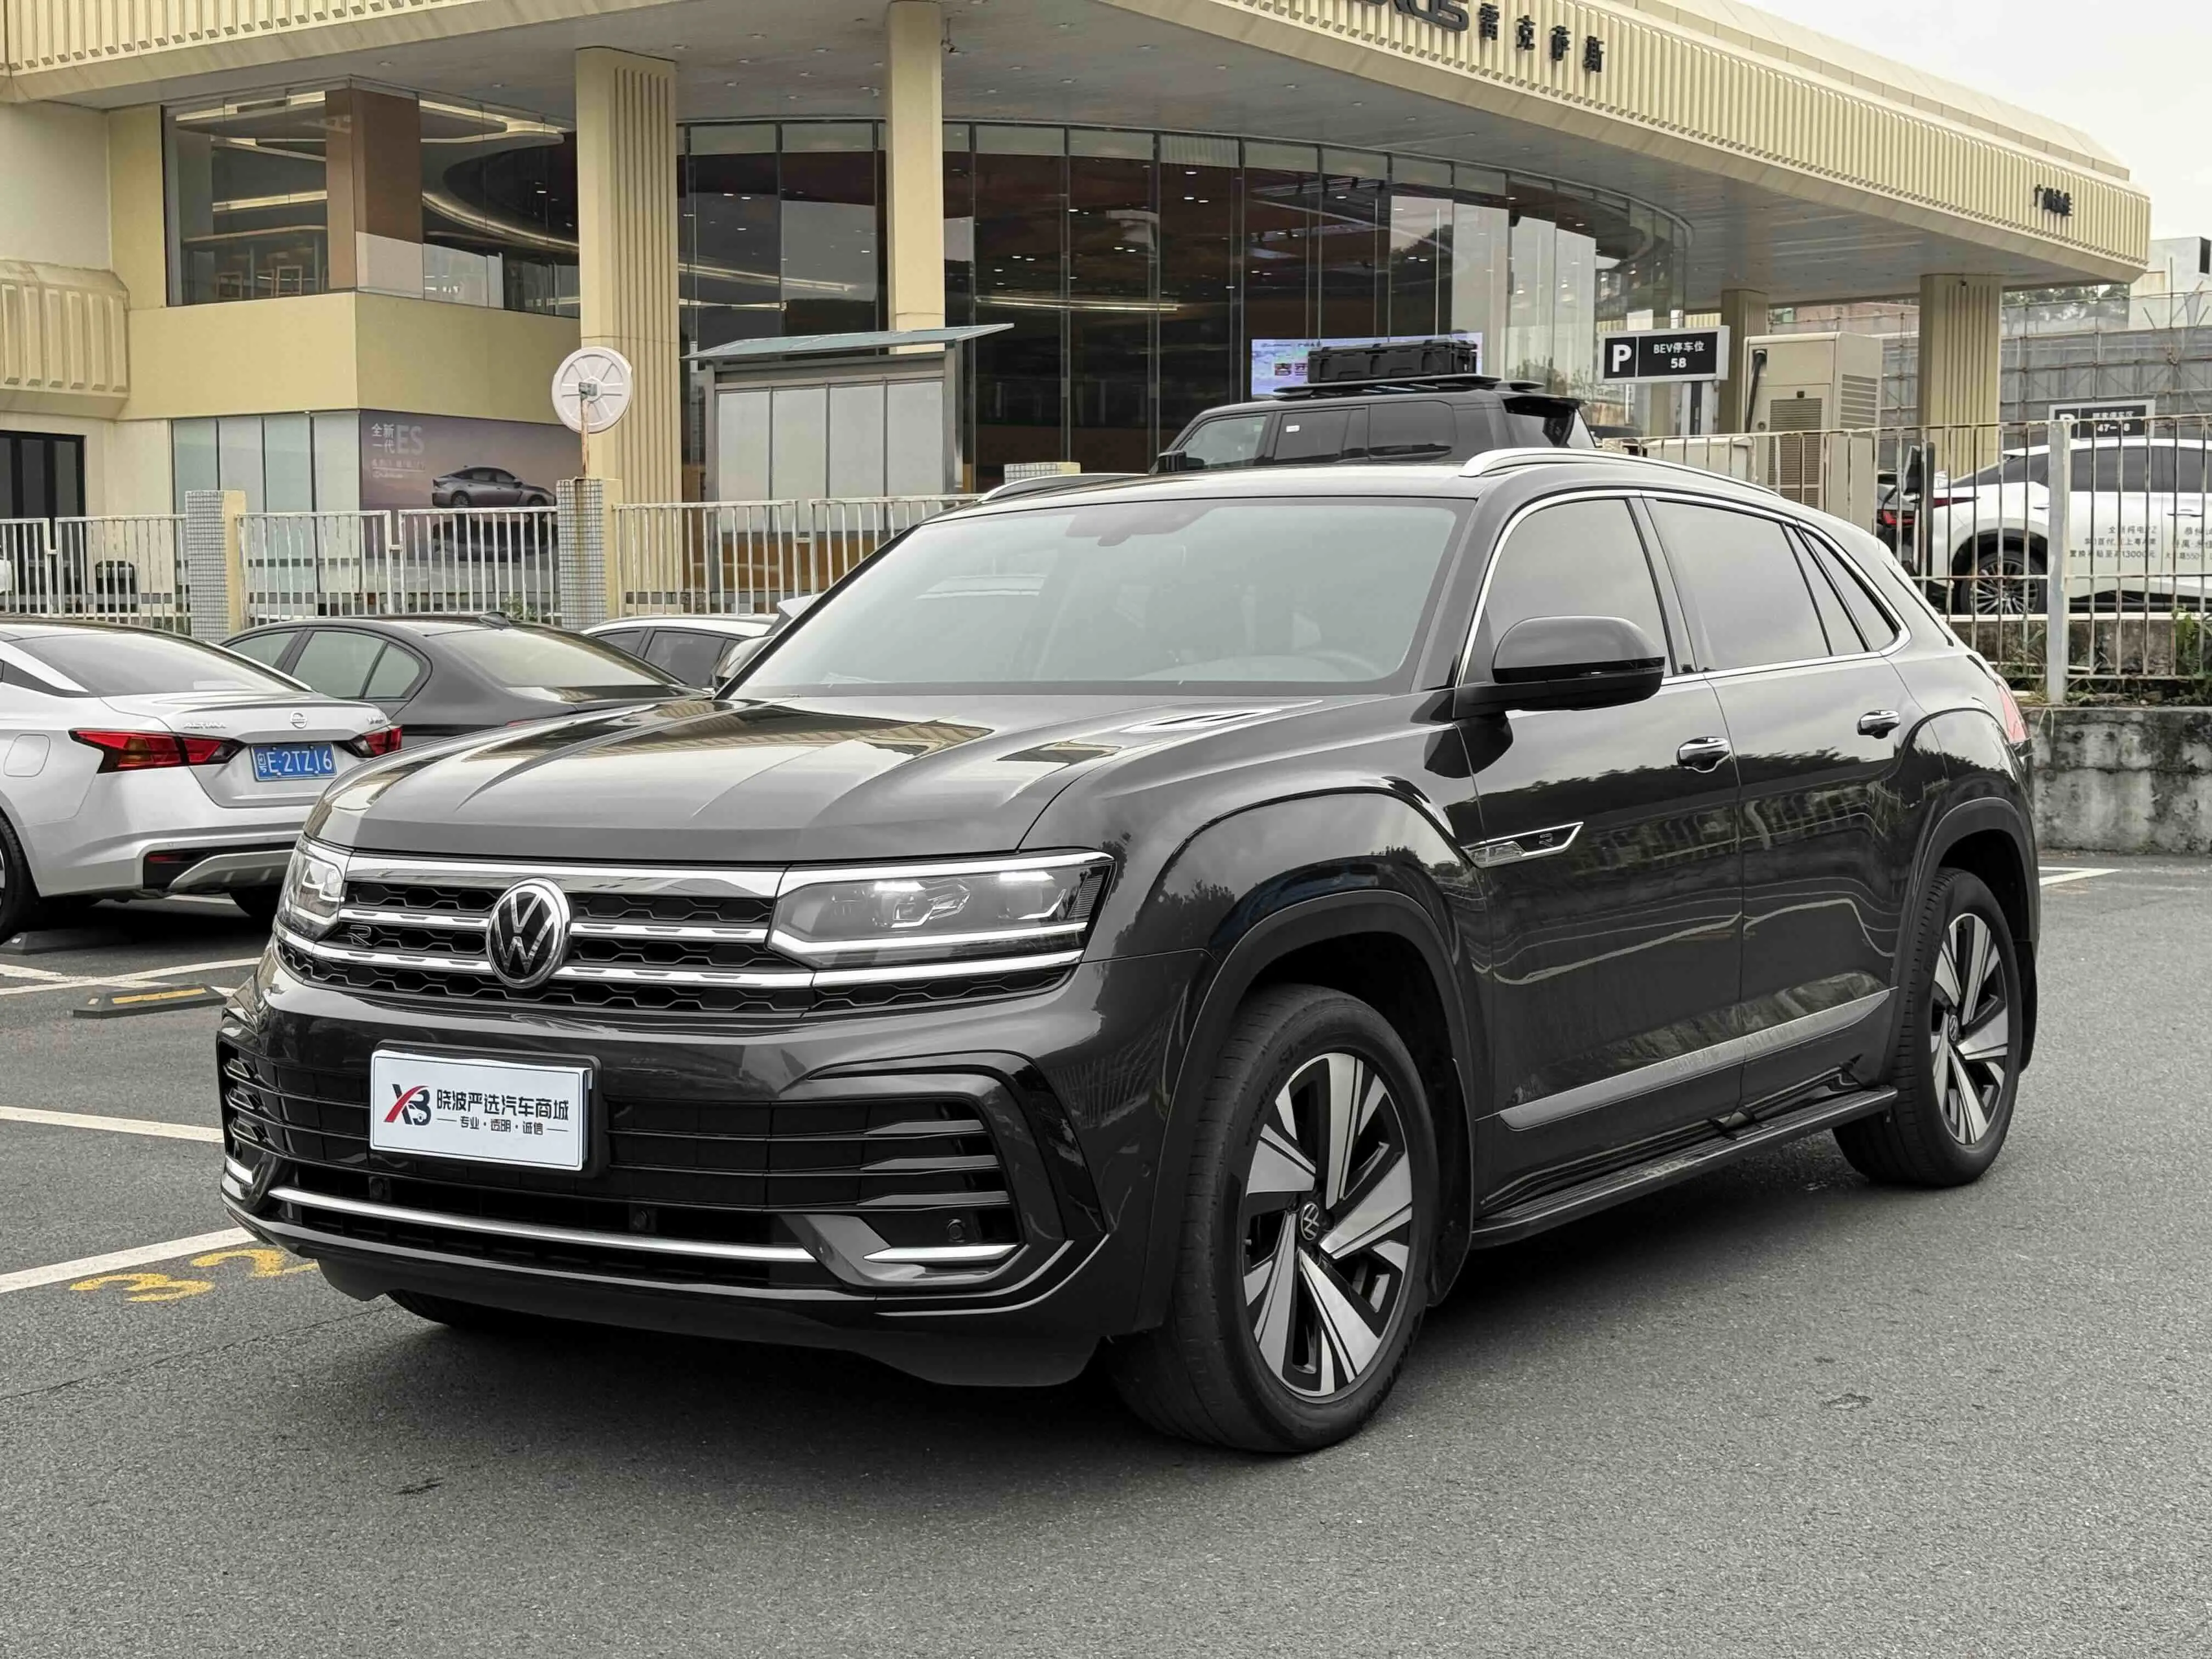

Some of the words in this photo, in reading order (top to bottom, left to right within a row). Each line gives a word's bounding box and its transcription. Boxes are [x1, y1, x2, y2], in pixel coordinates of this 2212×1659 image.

[1612, 345, 1632, 372] P
[1654, 341, 1706, 354] BEV停车位
[396, 425, 425, 456] ES
[437, 1089, 569, 1121] 晓波严选汽车商城
